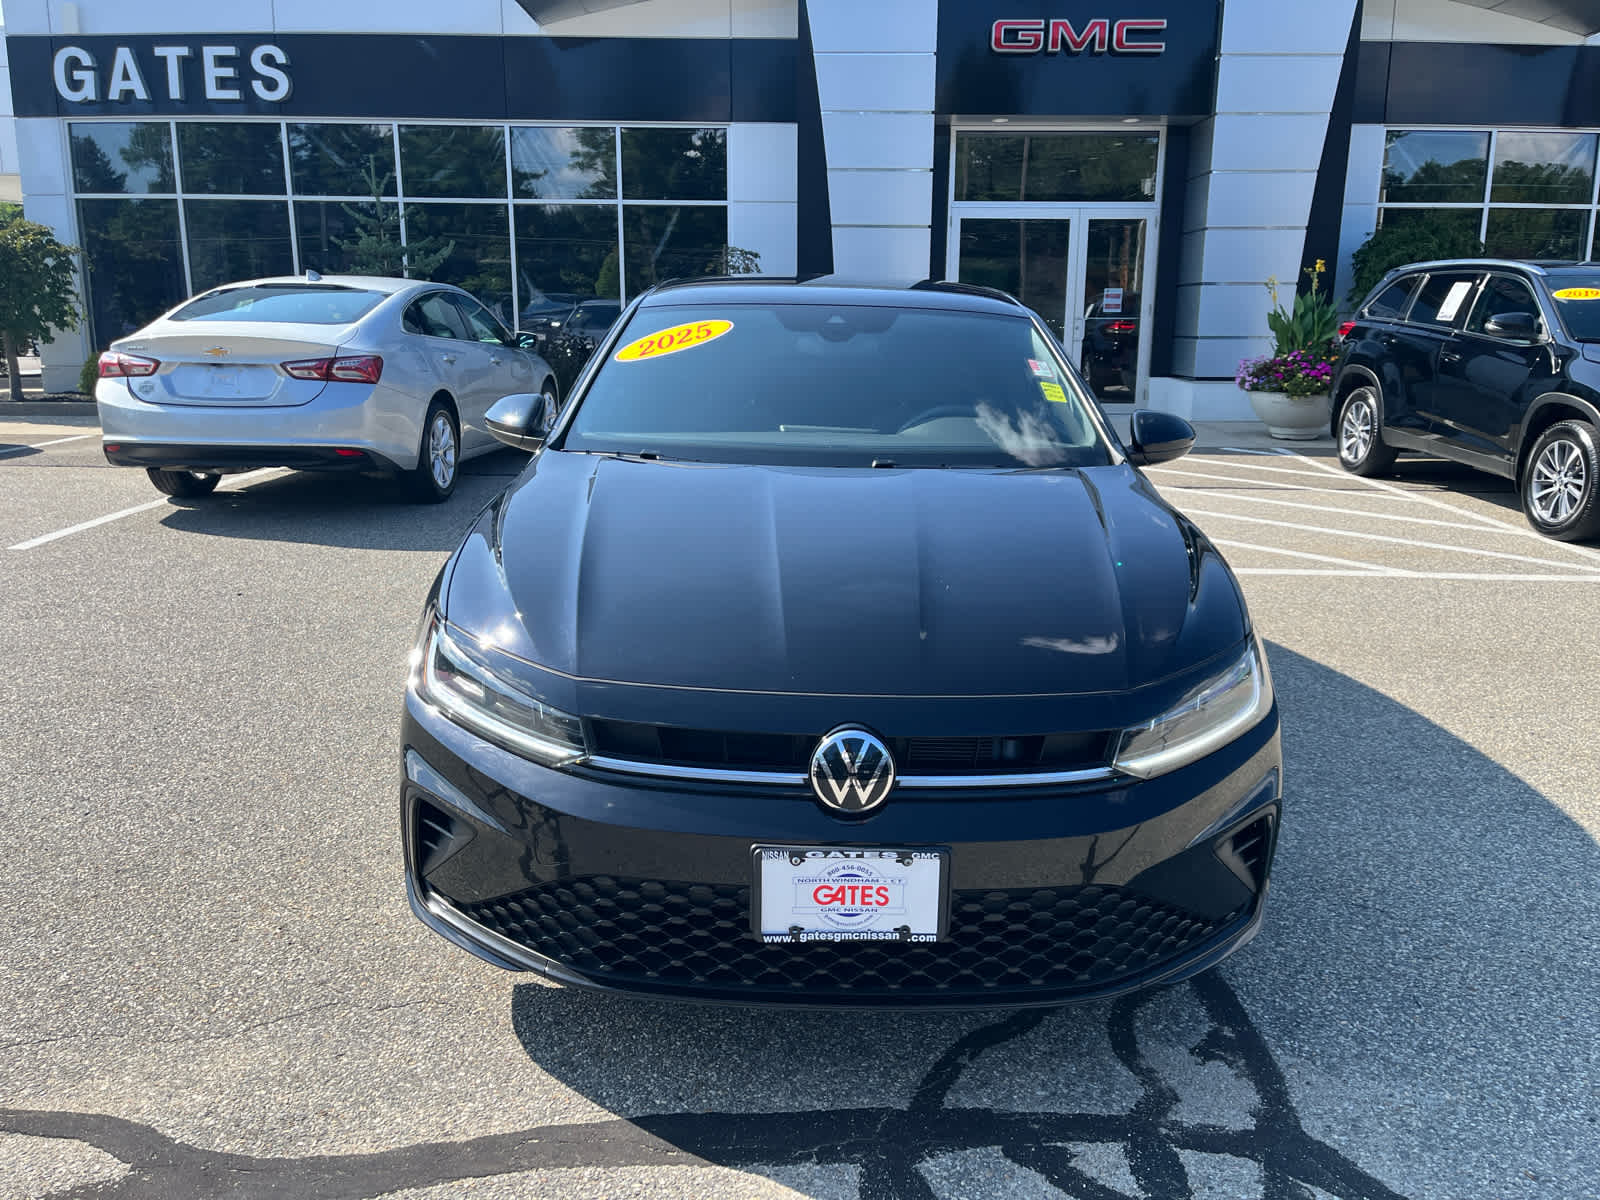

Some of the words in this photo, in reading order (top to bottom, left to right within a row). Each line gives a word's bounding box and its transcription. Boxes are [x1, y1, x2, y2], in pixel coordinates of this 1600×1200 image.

[991, 18, 1168, 53] GMC
[53, 44, 292, 102] GATES
[638, 322, 712, 357] 2025
[762, 850, 790, 861] NISSAN
[805, 850, 899, 859] GATES
[911, 852, 940, 860] GMC
[812, 884, 890, 907] GATES
[763, 934, 796, 943] www.
[799, 929, 900, 942] gatesgmcnissan
[907, 933, 937, 942] .com
